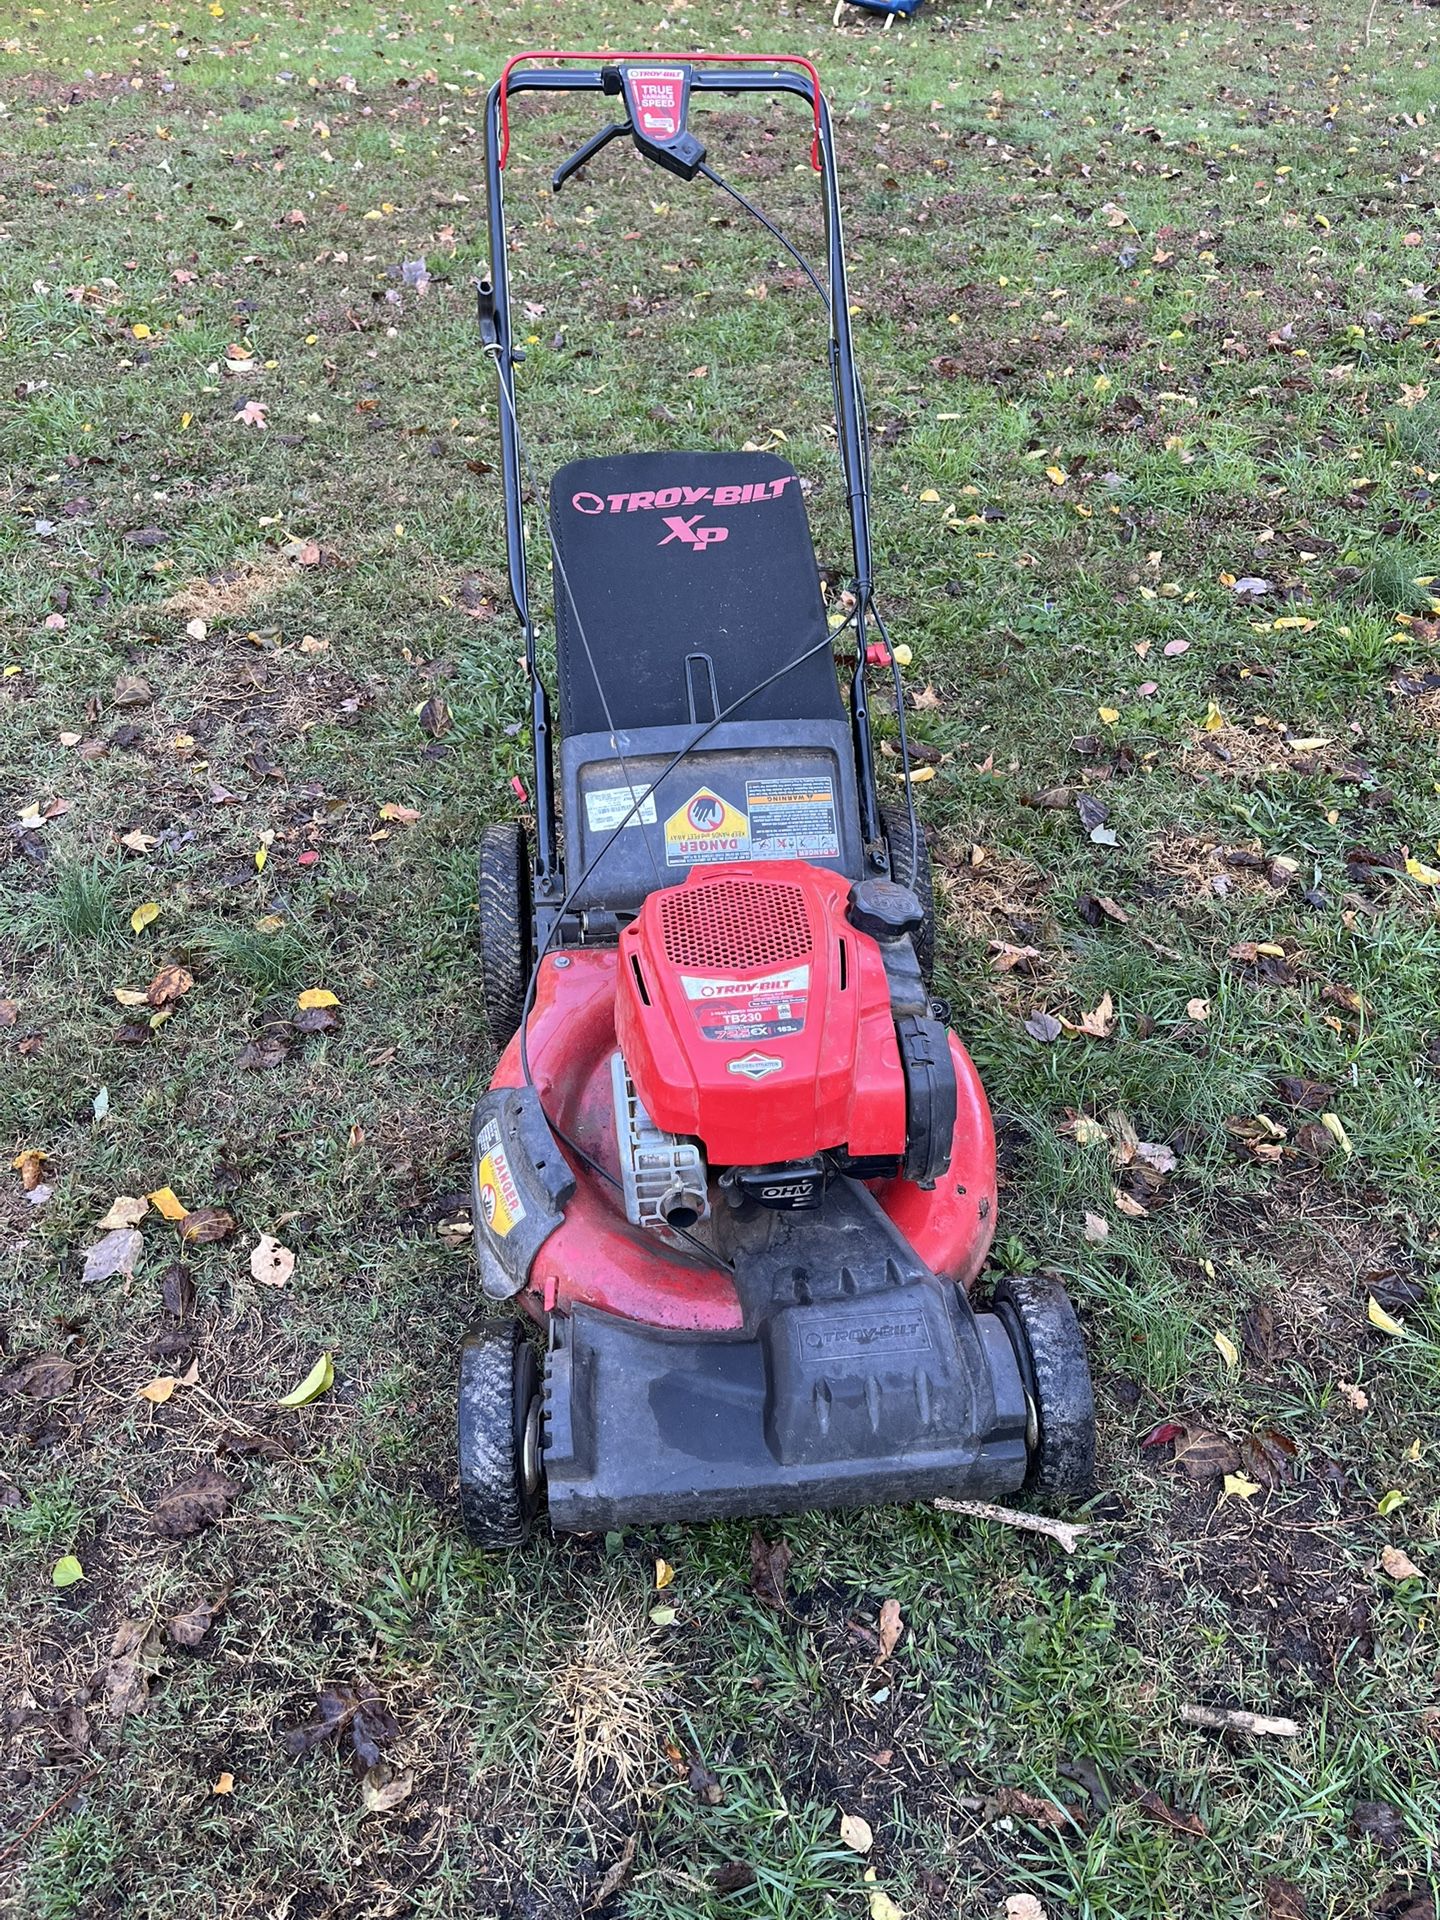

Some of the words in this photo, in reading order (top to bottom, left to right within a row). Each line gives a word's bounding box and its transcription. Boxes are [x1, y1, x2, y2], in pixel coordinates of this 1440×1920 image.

[641, 85, 673, 94] TRUE
[606, 476, 792, 514] TROY-BILT
[766, 794, 805, 802] WARNING
[680, 839, 738, 852] DANGER
[798, 848, 829, 856] DANGER
[715, 980, 791, 994] TROY-BILT
[723, 1012, 762, 1024] TB230
[494, 1154, 519, 1210] DANGER
[762, 1183, 813, 1199] OHV
[824, 1323, 919, 1342] TROY-BILT
